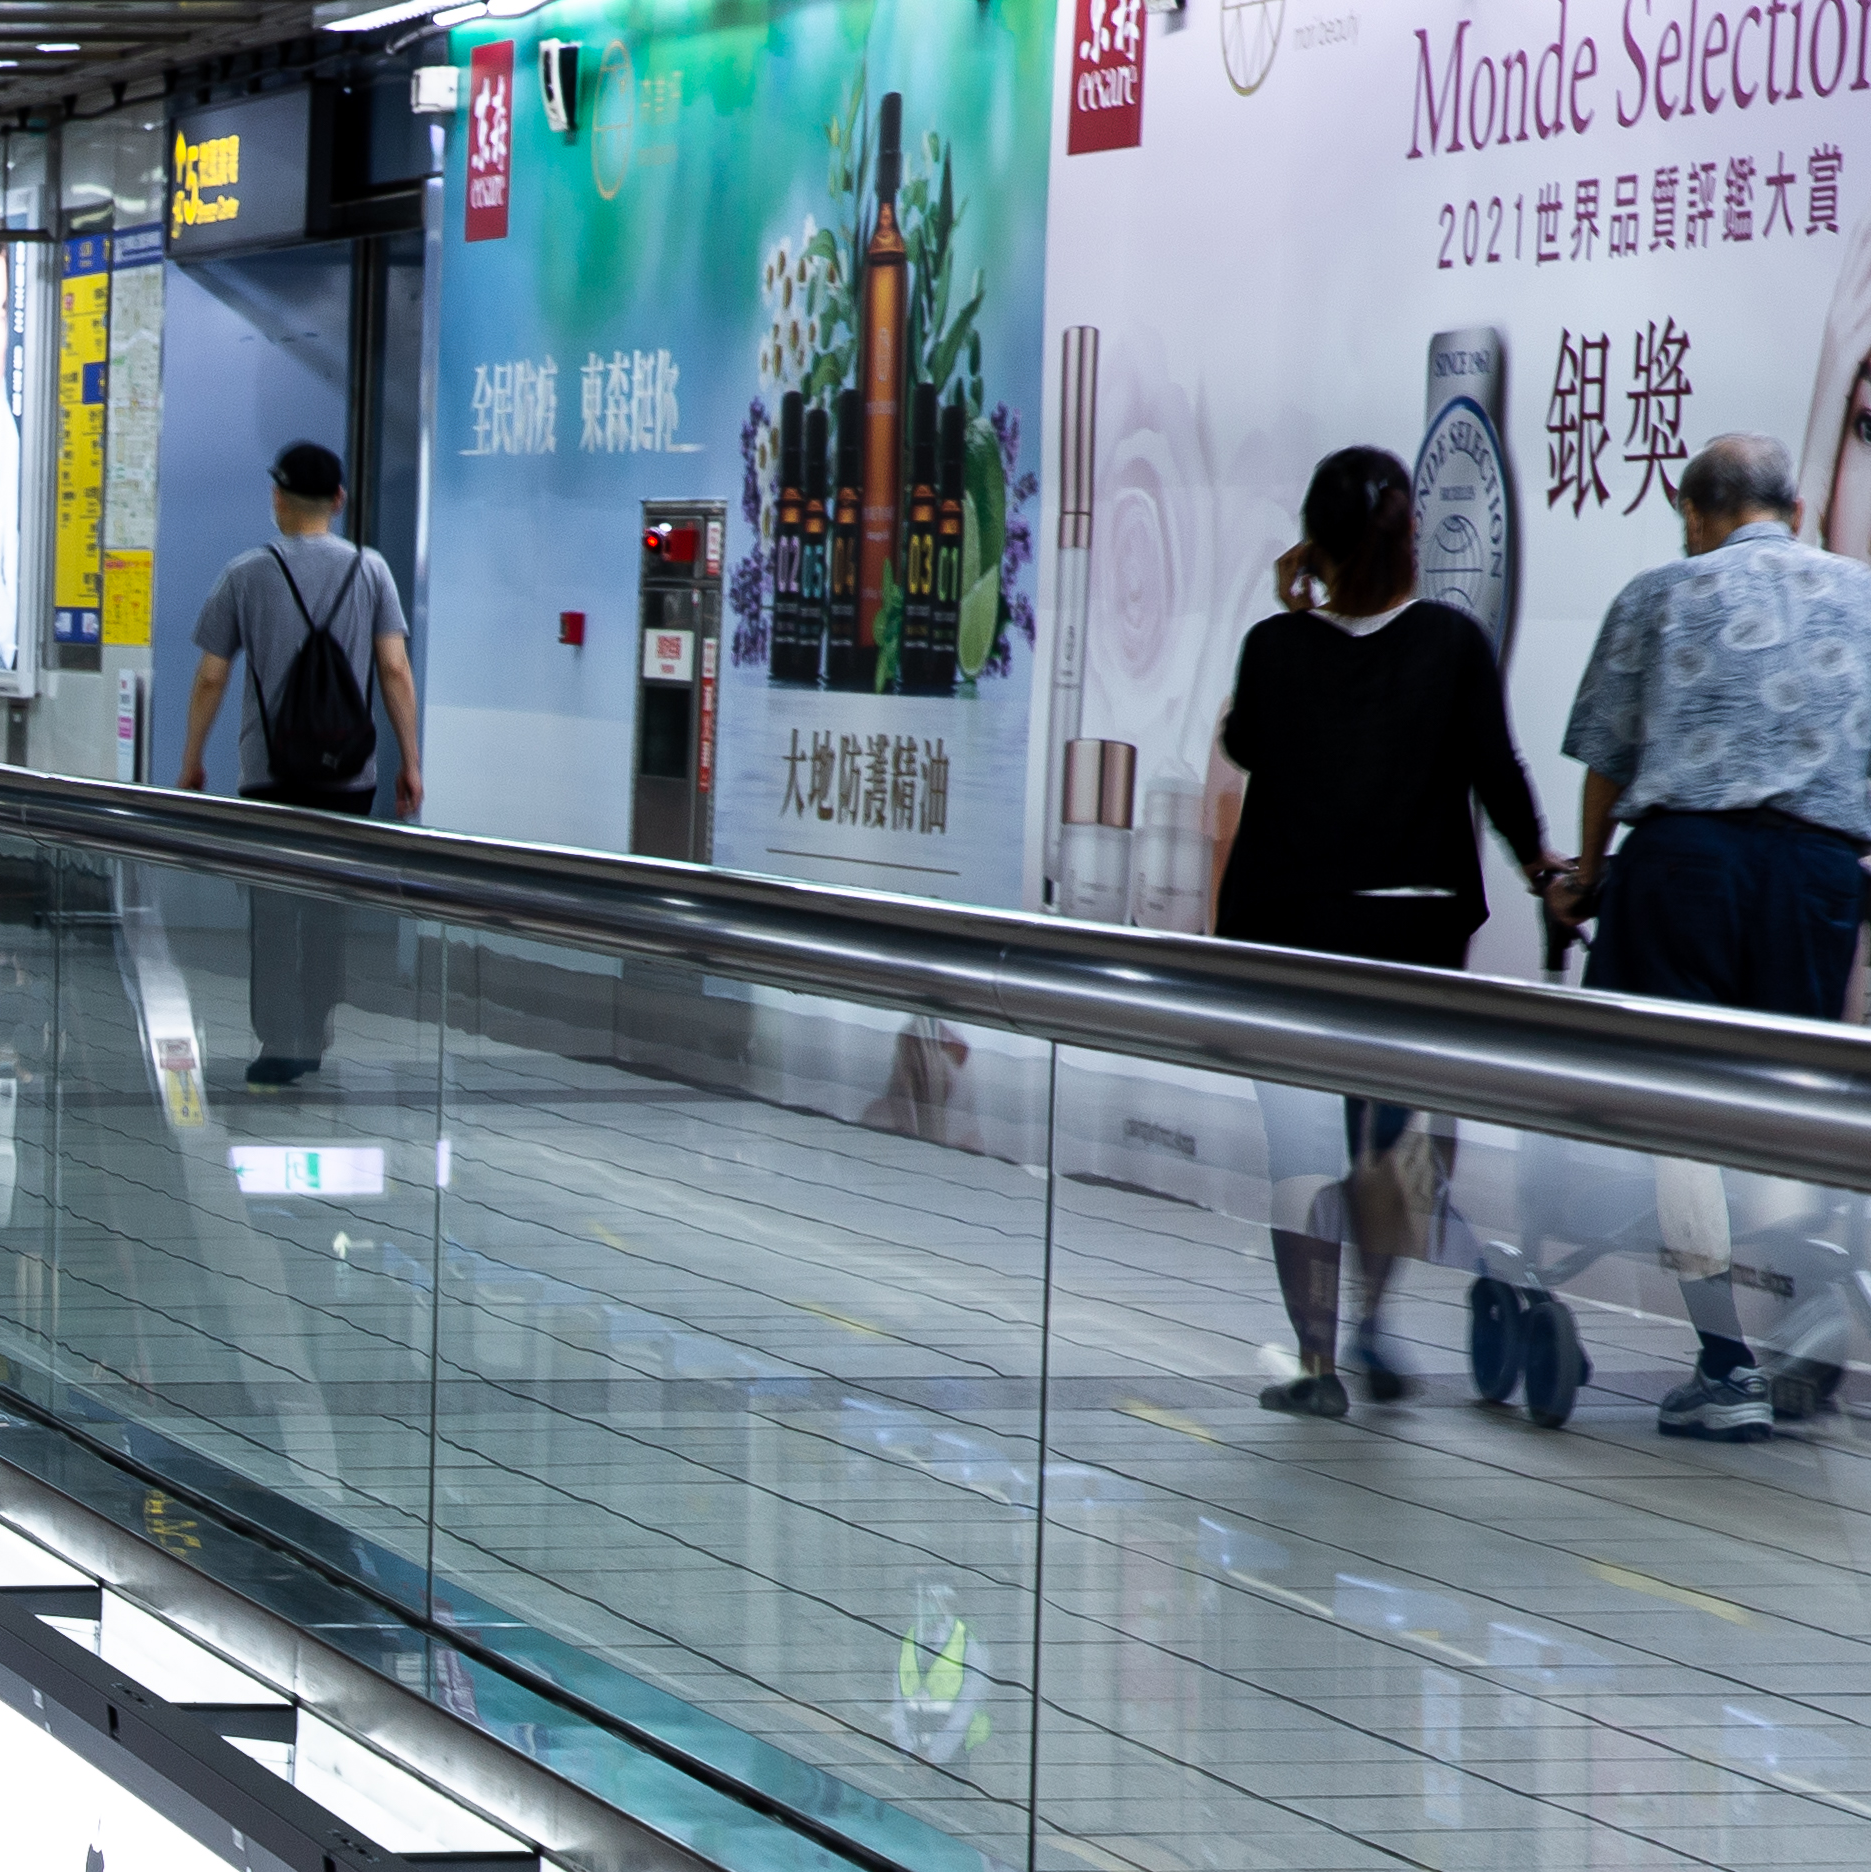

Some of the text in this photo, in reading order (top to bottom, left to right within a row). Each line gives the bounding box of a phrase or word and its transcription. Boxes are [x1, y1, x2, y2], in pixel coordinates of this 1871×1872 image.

[1406, 0, 1598, 160] Monde
[459, 353, 559, 456] 全民防疫
[908, 534, 934, 595] 03
[778, 728, 949, 835] 大地防護精油
